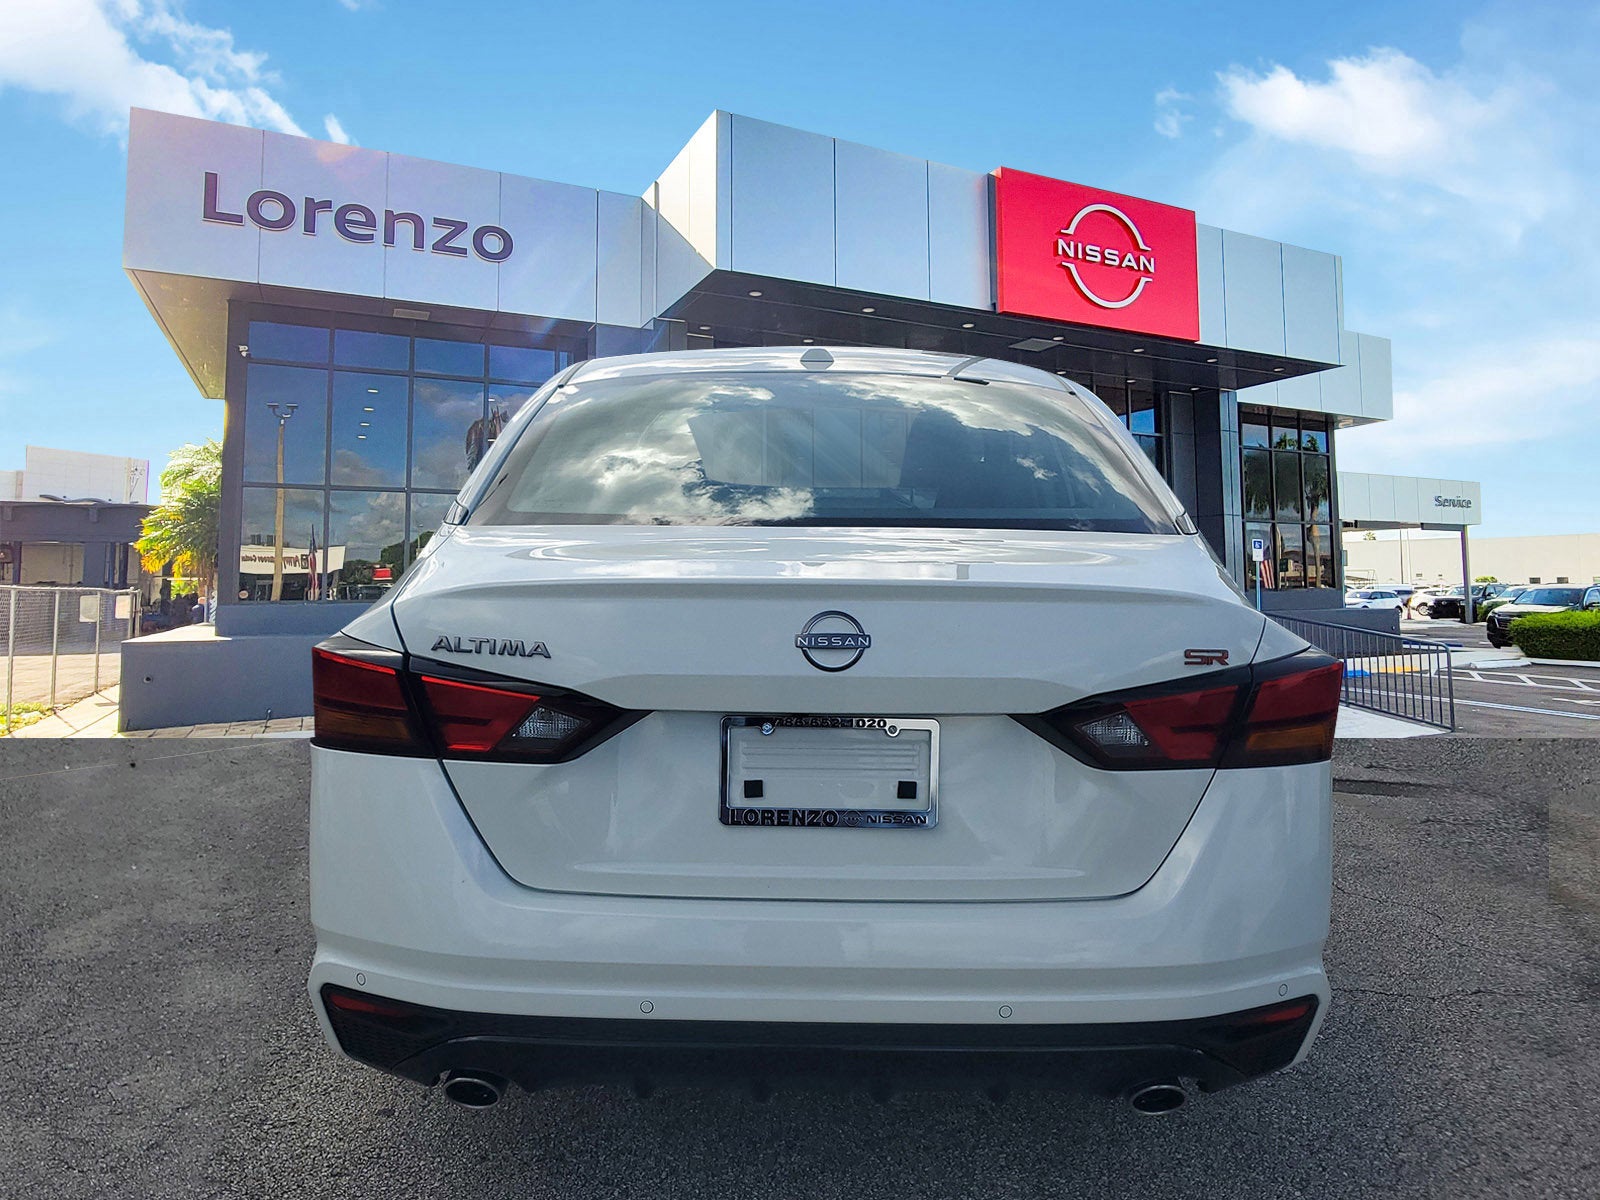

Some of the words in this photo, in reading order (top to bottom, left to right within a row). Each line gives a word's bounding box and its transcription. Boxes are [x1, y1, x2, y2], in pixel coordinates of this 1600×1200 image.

[202, 171, 514, 262] Lorenzo
[1057, 238, 1155, 273] NISSAN
[1434, 495, 1472, 508] Service
[431, 635, 551, 658] ALTIMA
[797, 636, 869, 646] NISSAN
[1184, 649, 1229, 665] SR
[728, 808, 839, 826] LORENZO
[866, 814, 928, 824] NISSAN
